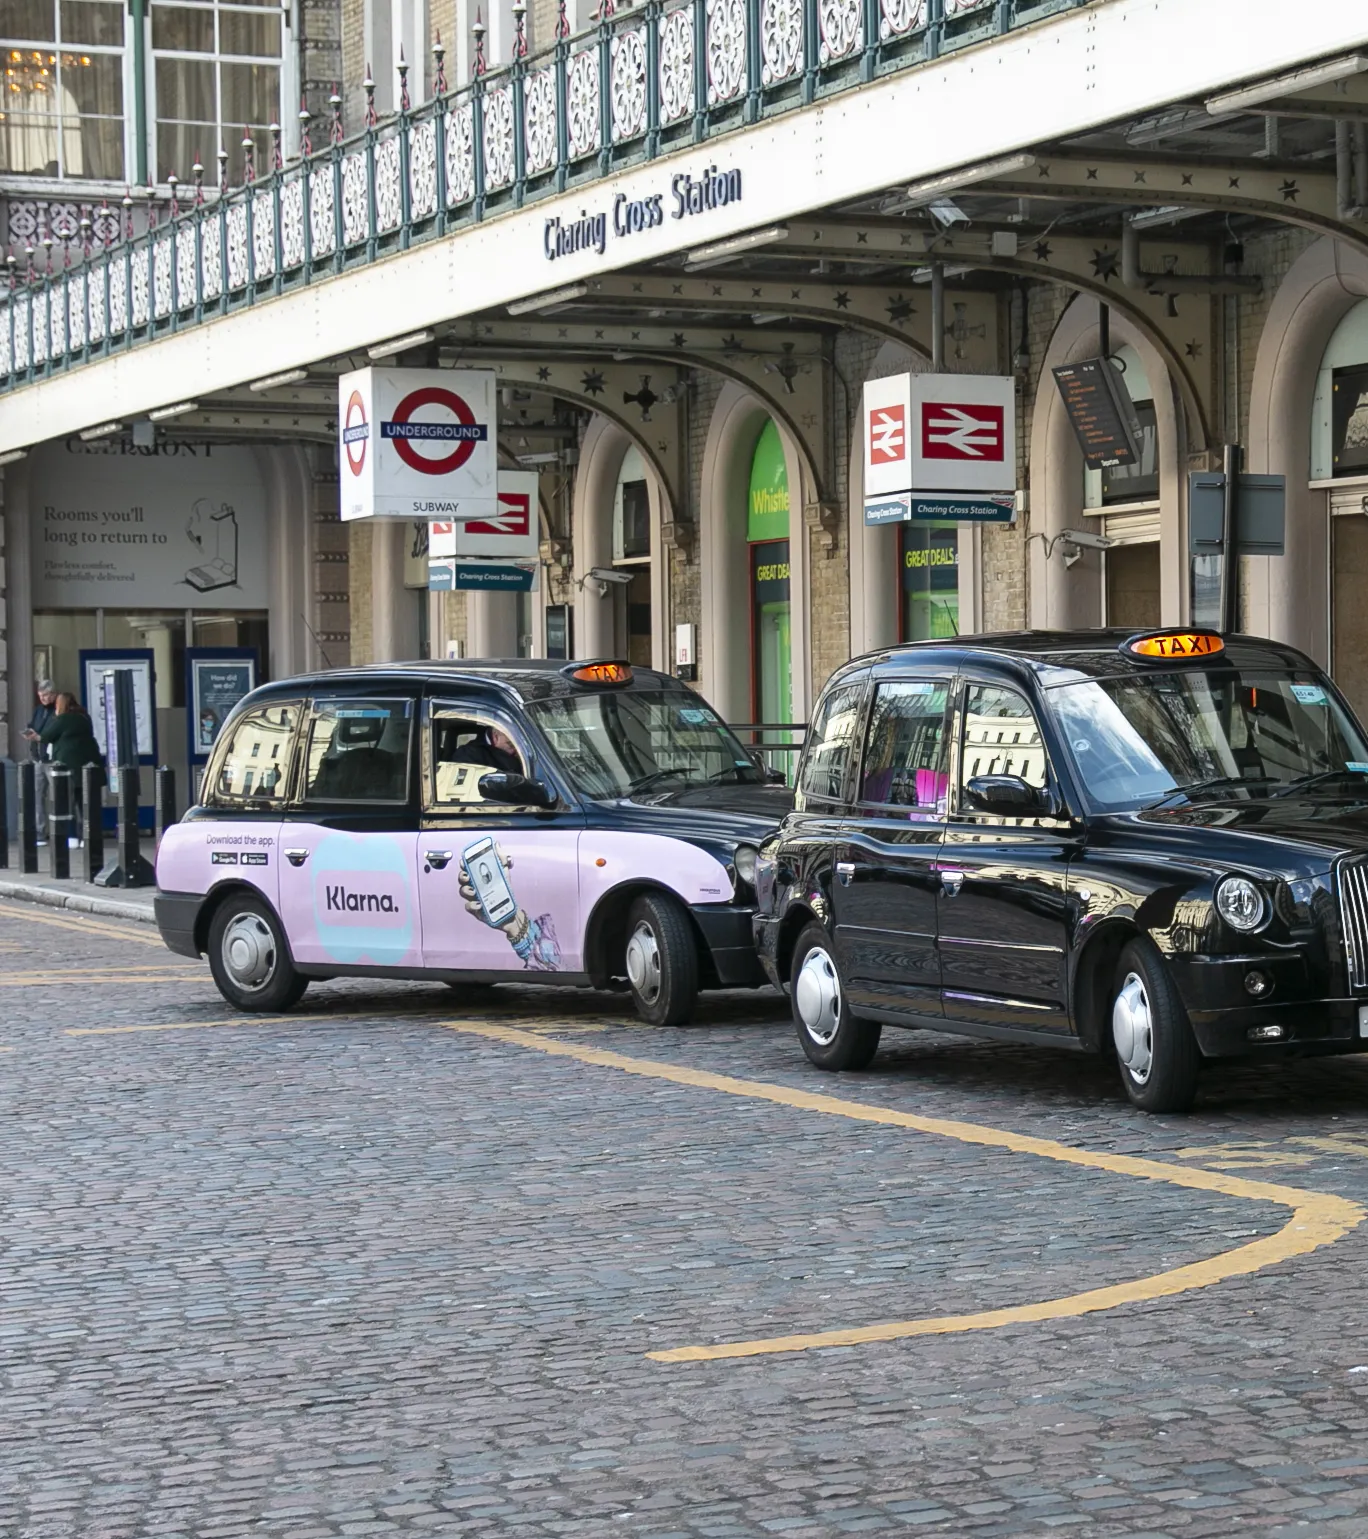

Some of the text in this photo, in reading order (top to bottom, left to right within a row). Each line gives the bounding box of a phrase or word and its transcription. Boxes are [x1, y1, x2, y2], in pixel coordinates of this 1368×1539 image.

[544, 165, 742, 260] Charing Cross Station
[386, 424, 481, 438] UNDERGROUND
[413, 502, 459, 512] SUBWAY
[917, 504, 998, 516] Charing Cross Station
[44, 507, 144, 526] Rooms you'll
[44, 528, 168, 546] long to return to
[905, 549, 930, 568] GREAT
[930, 547, 954, 566] DEALS
[459, 572, 483, 581] Charing
[757, 564, 777, 581] GREAT
[1155, 637, 1211, 654] TAXI
[206, 834, 275, 848] Download the app.
